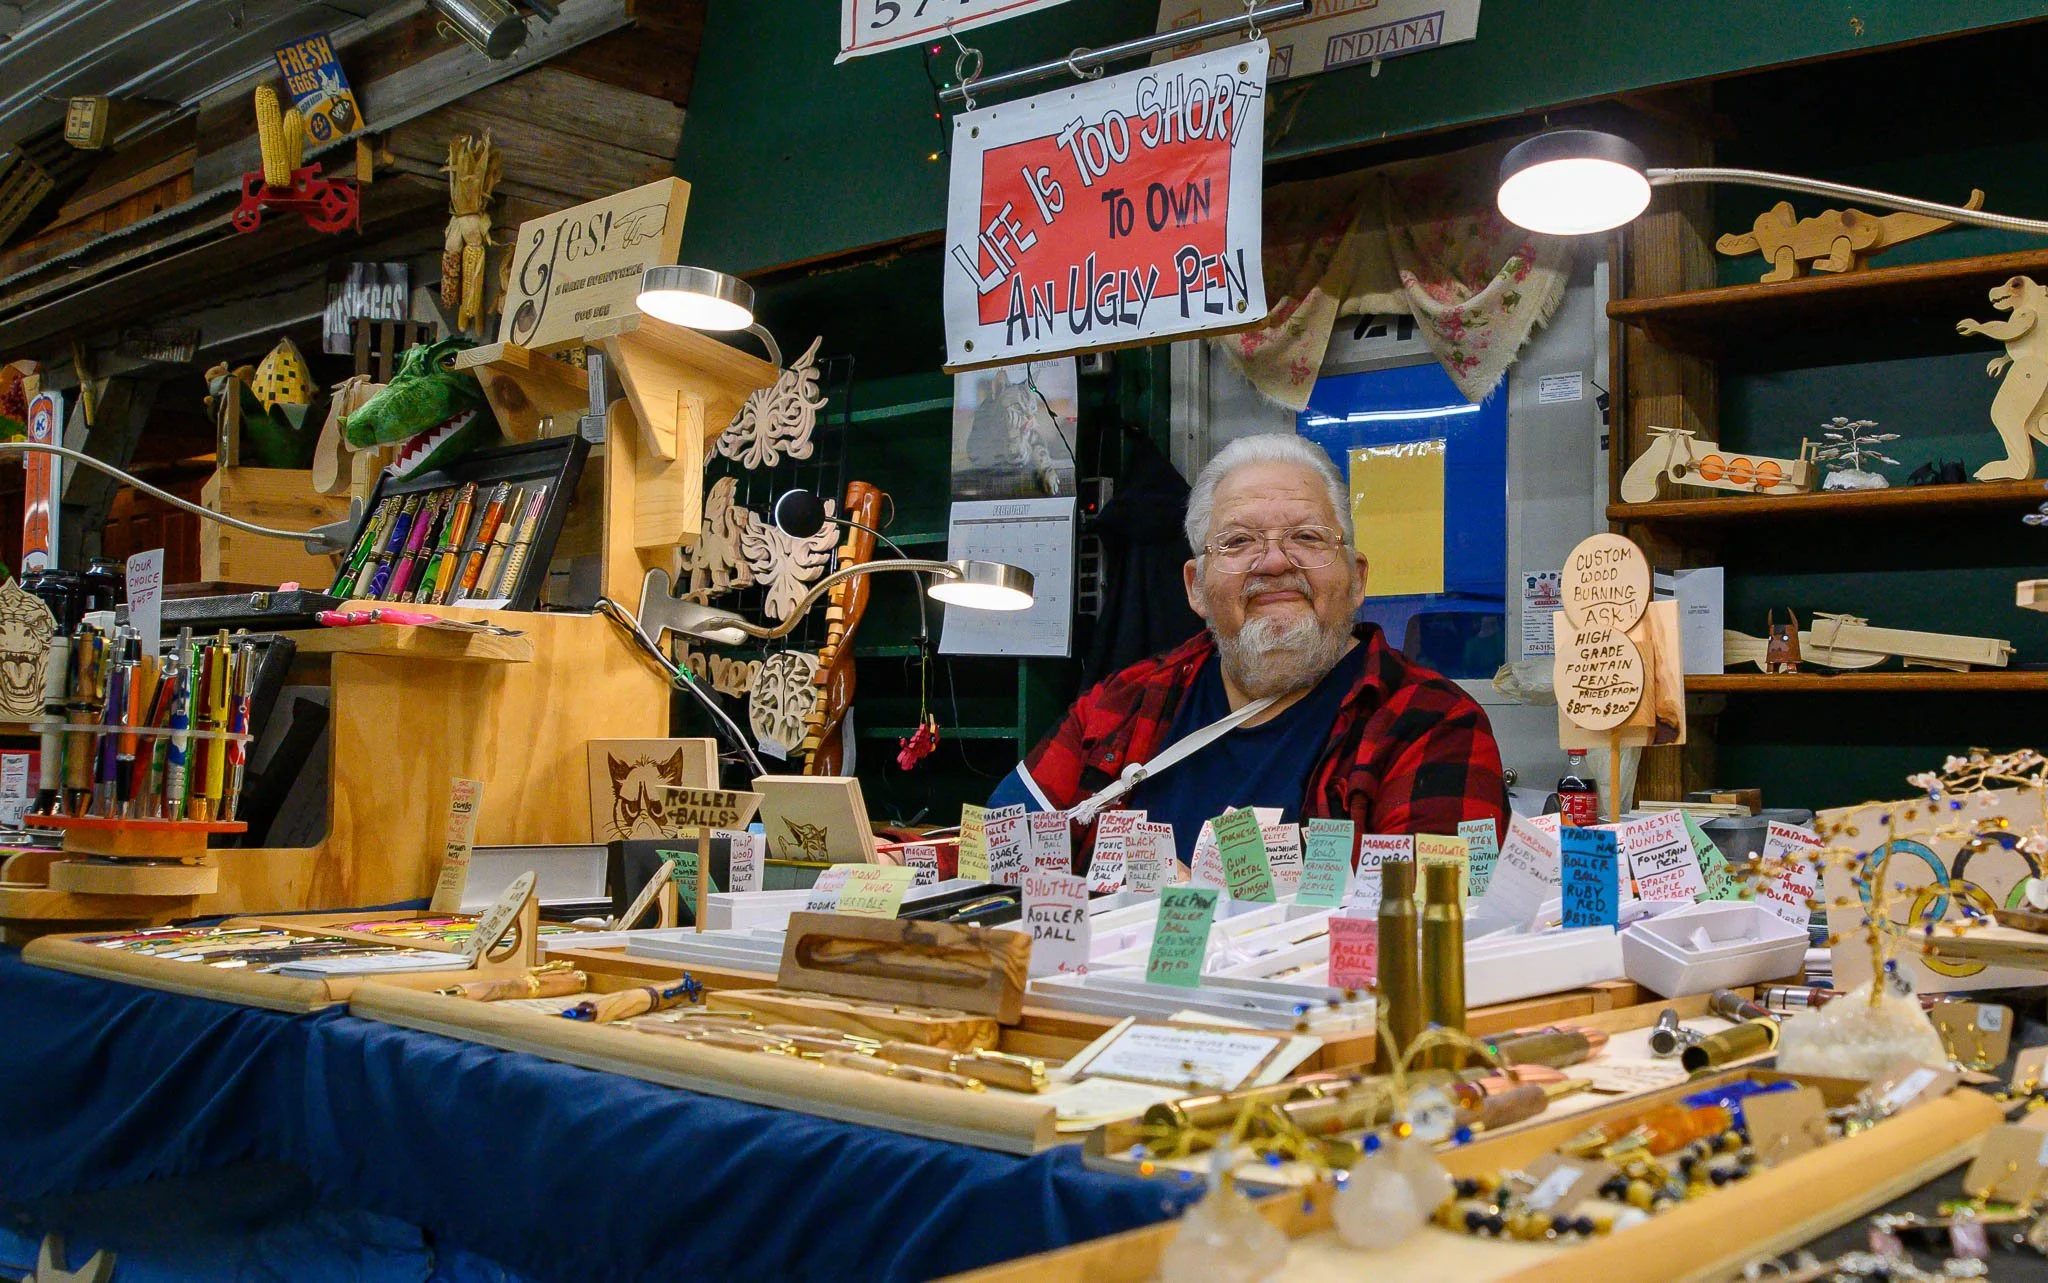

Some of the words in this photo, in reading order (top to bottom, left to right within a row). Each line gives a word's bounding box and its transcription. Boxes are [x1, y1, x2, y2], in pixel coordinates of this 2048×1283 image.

[1329, 19, 1436, 63] INDIANA
[276, 36, 334, 77] FRESH
[287, 70, 319, 95] EGGS
[951, 203, 1037, 297] LIFE
[1022, 165, 1064, 225] IS
[1057, 113, 1130, 188] TOO
[1135, 73, 1263, 149] SHORT
[1101, 187, 1134, 239] TO
[1146, 177, 1211, 233] OWN
[1006, 273, 1055, 346] AN
[1068, 251, 1159, 335] UGLY
[1174, 245, 1250, 319] PEN
[129, 559, 152, 573] YOUR
[1576, 548, 1632, 571] CUSTOM
[129, 572, 160, 587] CHOICE
[1580, 568, 1618, 584] WOOD
[1573, 585, 1637, 602] BURNING
[1584, 607, 1624, 626] ASK
[1575, 630, 1612, 645] HIGH
[1580, 645, 1625, 659] GRADE
[1565, 659, 1633, 674] FOUNTAIN
[1578, 674, 1620, 687] PENS
[1578, 687, 1610, 699] PRICED
[1611, 685, 1639, 698] FROM
[665, 788, 737, 808] ROLLER
[452, 801, 472, 811] COMBO
[675, 807, 729, 828] BALLS
[984, 807, 1022, 821] MAGNETIC
[1033, 812, 1069, 822] MAGNETIC
[1101, 814, 1136, 826] PREMIUM
[1214, 810, 1252, 828] GRADUATE
[1033, 820, 1066, 830] GRADUATE
[1136, 823, 1171, 834] CLASSIC
[1309, 821, 1350, 833] GRADUATE
[1459, 823, 1494, 834] MAGNETIC
[1626, 812, 1680, 837] MAJESTIC
[733, 835, 752, 848] TULIP
[990, 835, 1011, 847] BALL
[1038, 833, 1064, 841] ROLLER
[1125, 836, 1157, 847] BLACK
[1264, 833, 1287, 841] ELITE
[1362, 838, 1410, 850] MANAGER
[1629, 830, 1674, 850] JUNIOR
[905, 847, 935, 858] MAGNETIC
[1097, 841, 1122, 850] TOXIC
[1265, 844, 1298, 853] SUNSHINE
[733, 848, 753, 861] WOOD
[990, 845, 1020, 862] OSAGE
[1095, 851, 1123, 861] GREEN
[1126, 850, 1156, 859] WATCH
[1270, 854, 1298, 862] ACRYLIC
[1468, 852, 1499, 861] OUNTAIN
[1638, 844, 1688, 866] FOUNTAIN
[907, 860, 938, 870] GRADUATE
[990, 853, 1023, 872] ORANGE
[1034, 856, 1069, 867] PEACOCK
[1090, 863, 1123, 872] ROLLER
[1226, 855, 1246, 872] GUN
[1304, 863, 1344, 873] RAINBOW
[1470, 863, 1489, 872] PEN
[1563, 855, 1610, 871] ROLLER
[732, 874, 752, 883] ROLLER
[1093, 872, 1112, 880] BALL
[1233, 864, 1262, 880] METAL
[1306, 872, 1334, 881] SWIRL
[1573, 870, 1602, 883] BALL
[1640, 869, 1685, 889] SPALTED
[731, 885, 745, 893] BALL
[1135, 881, 1152, 889] BALL
[1567, 884, 1604, 899] RUBY
[1643, 882, 1681, 898] PURPLE
[1766, 887, 1796, 906] BURL
[1027, 907, 1084, 924] ROLLER
[1034, 925, 1076, 941] BALL
[1334, 956, 1372, 971] BALL
